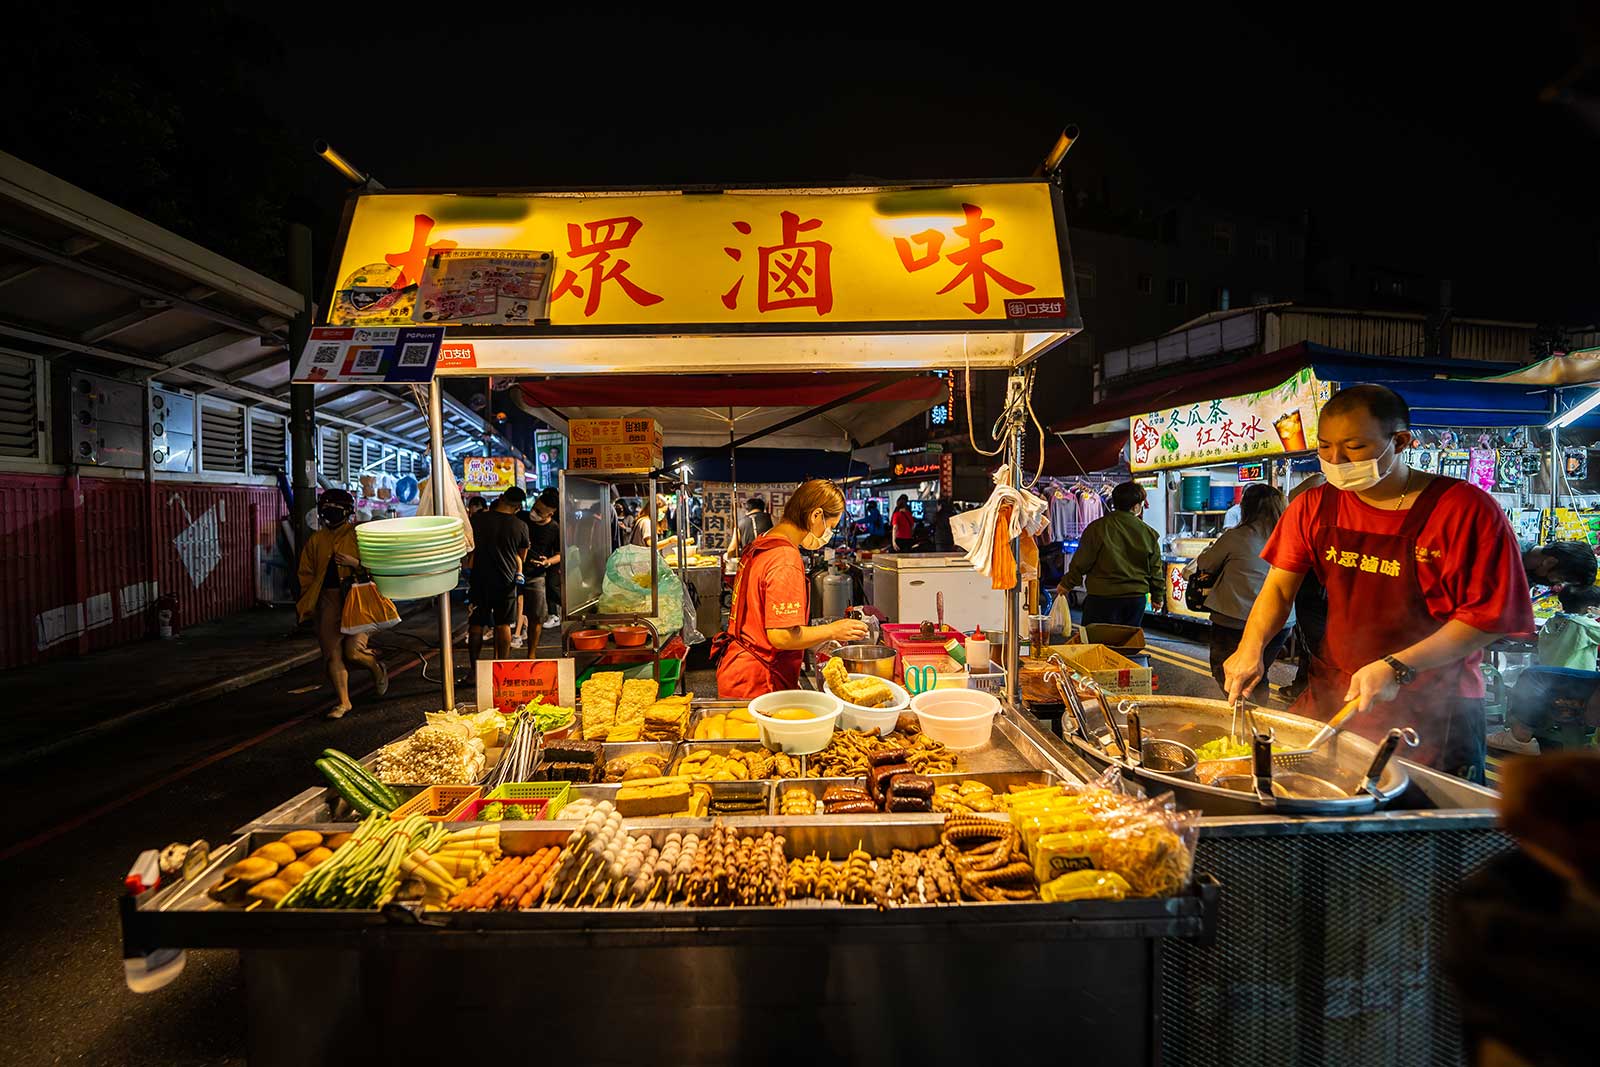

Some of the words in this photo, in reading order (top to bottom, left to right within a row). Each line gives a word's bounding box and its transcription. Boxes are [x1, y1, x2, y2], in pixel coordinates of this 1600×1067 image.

[1008, 301, 1062, 317] 街口支付
[1166, 399, 1229, 432] 冬瓜茶
[704, 492, 731, 549] 燒肉乾
[1325, 545, 1401, 577] 大眾滷味
